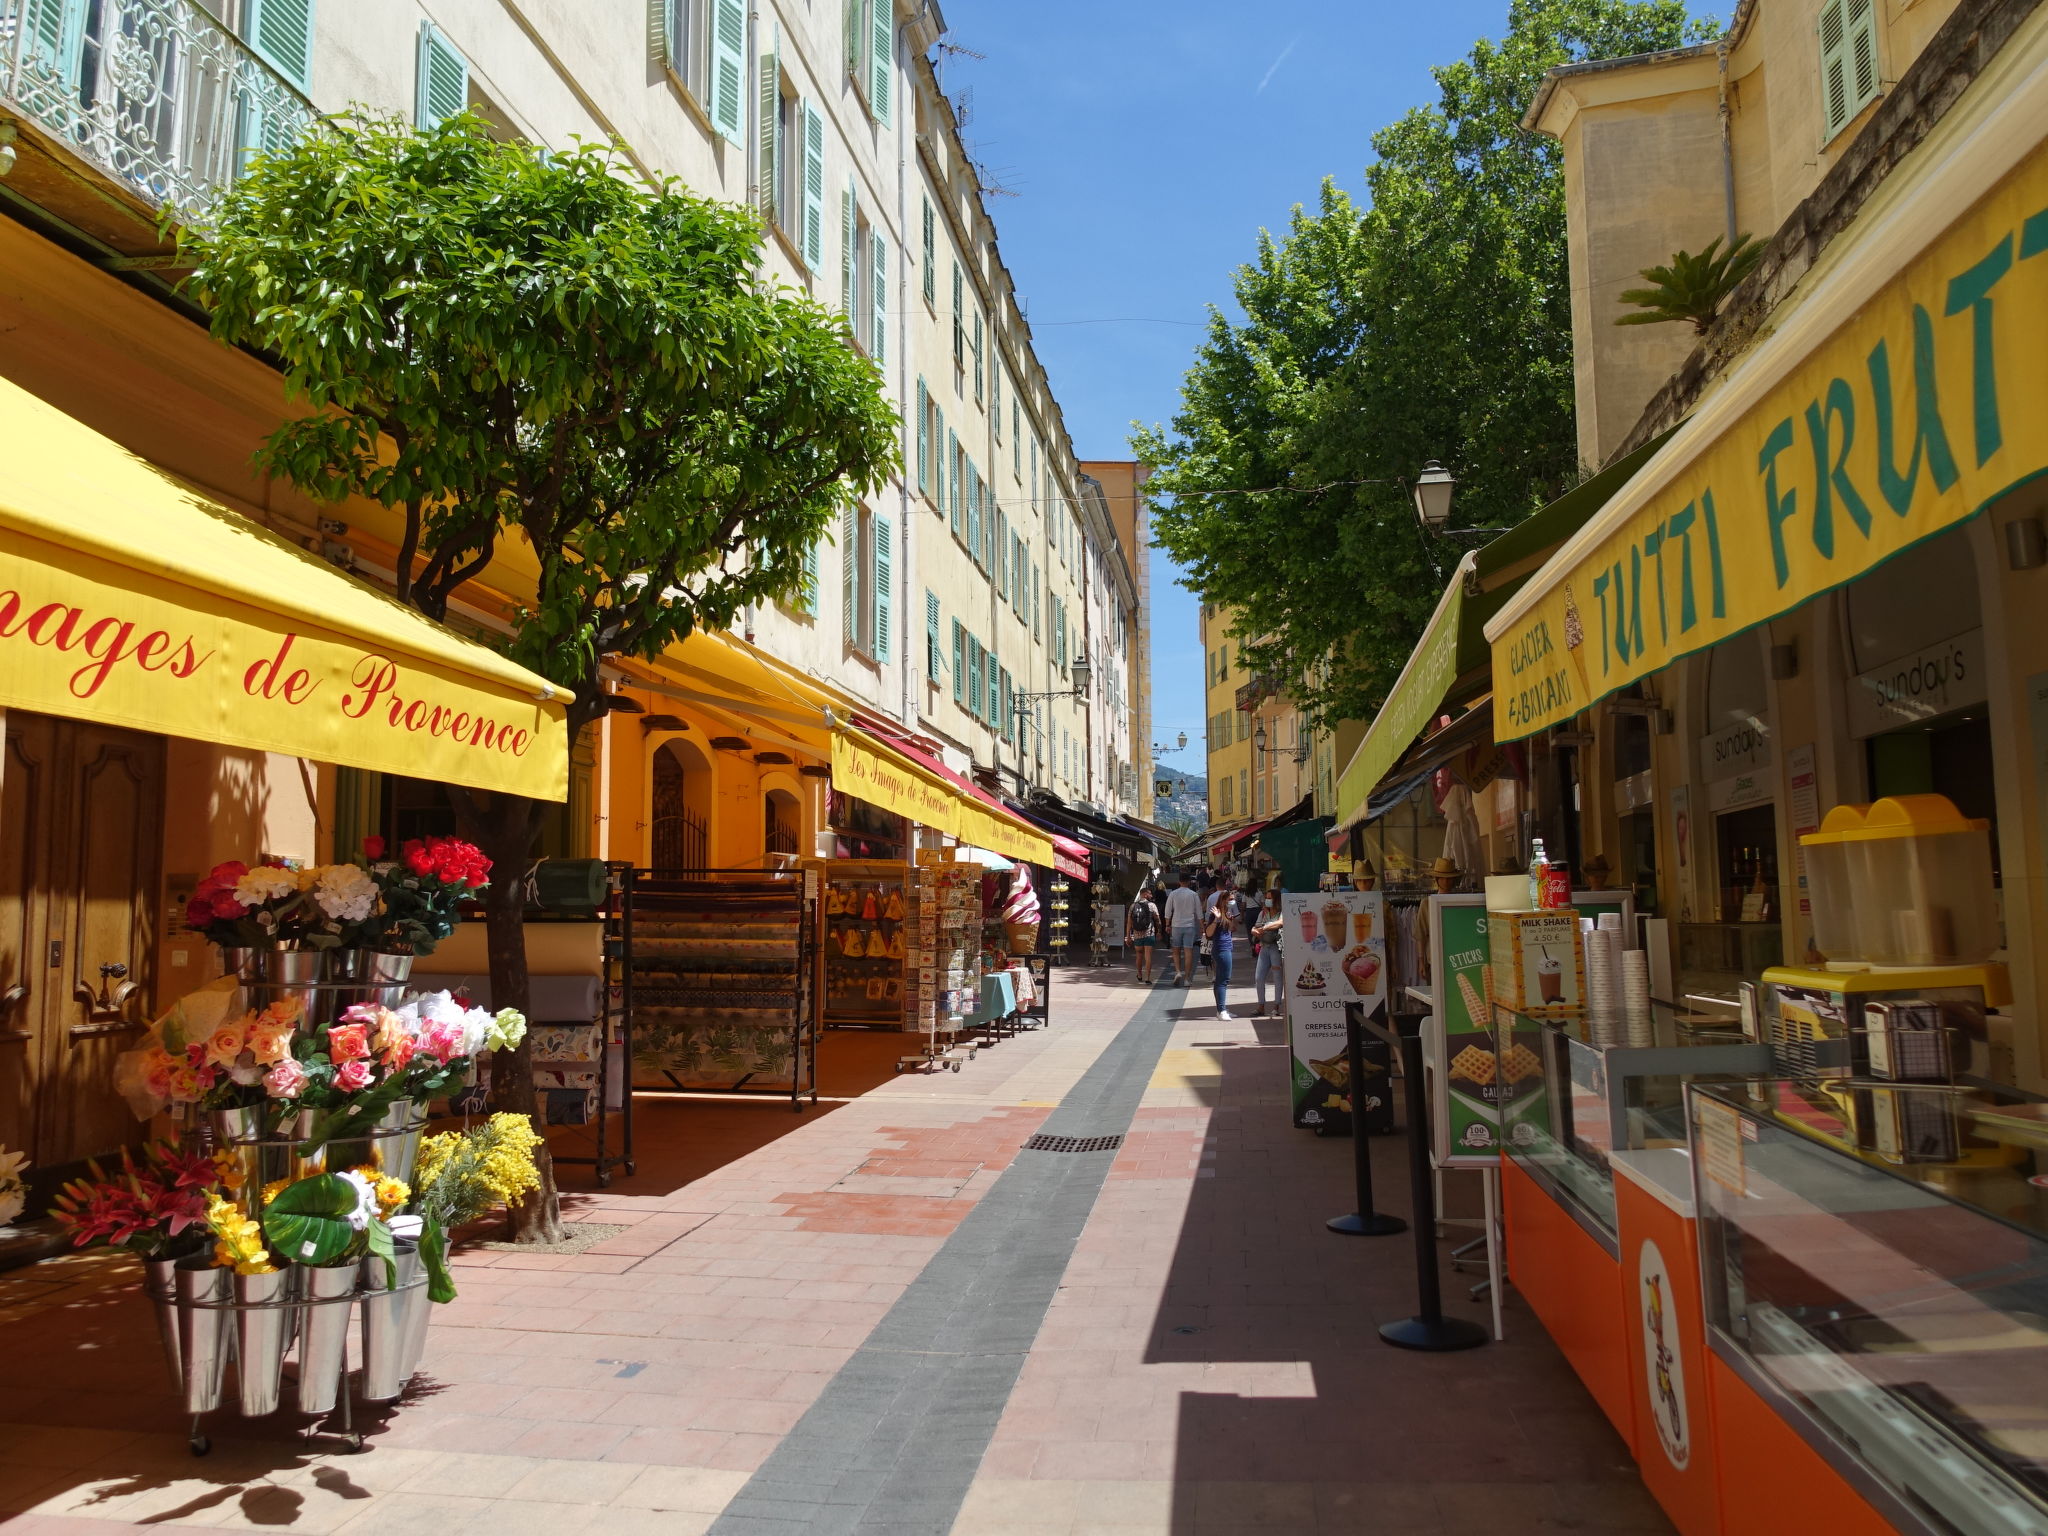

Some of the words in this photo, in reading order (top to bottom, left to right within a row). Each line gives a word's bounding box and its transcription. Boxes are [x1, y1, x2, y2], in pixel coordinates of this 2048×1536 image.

[1594, 486, 1726, 678] TUTTI
[1510, 620, 1553, 677] GLACIER
[1876, 644, 1965, 707] sunday's
[243, 633, 324, 705] de
[341, 654, 536, 757] Provence
[1508, 668, 1573, 727] FABRICANT
[849, 743, 865, 779] Les
[871, 754, 904, 805] Images
[1476, 918, 1487, 934] S
[1521, 919, 1541, 928] MILK
[1544, 917, 1571, 927] SHAKE
[1449, 949, 1484, 969] STICKS
